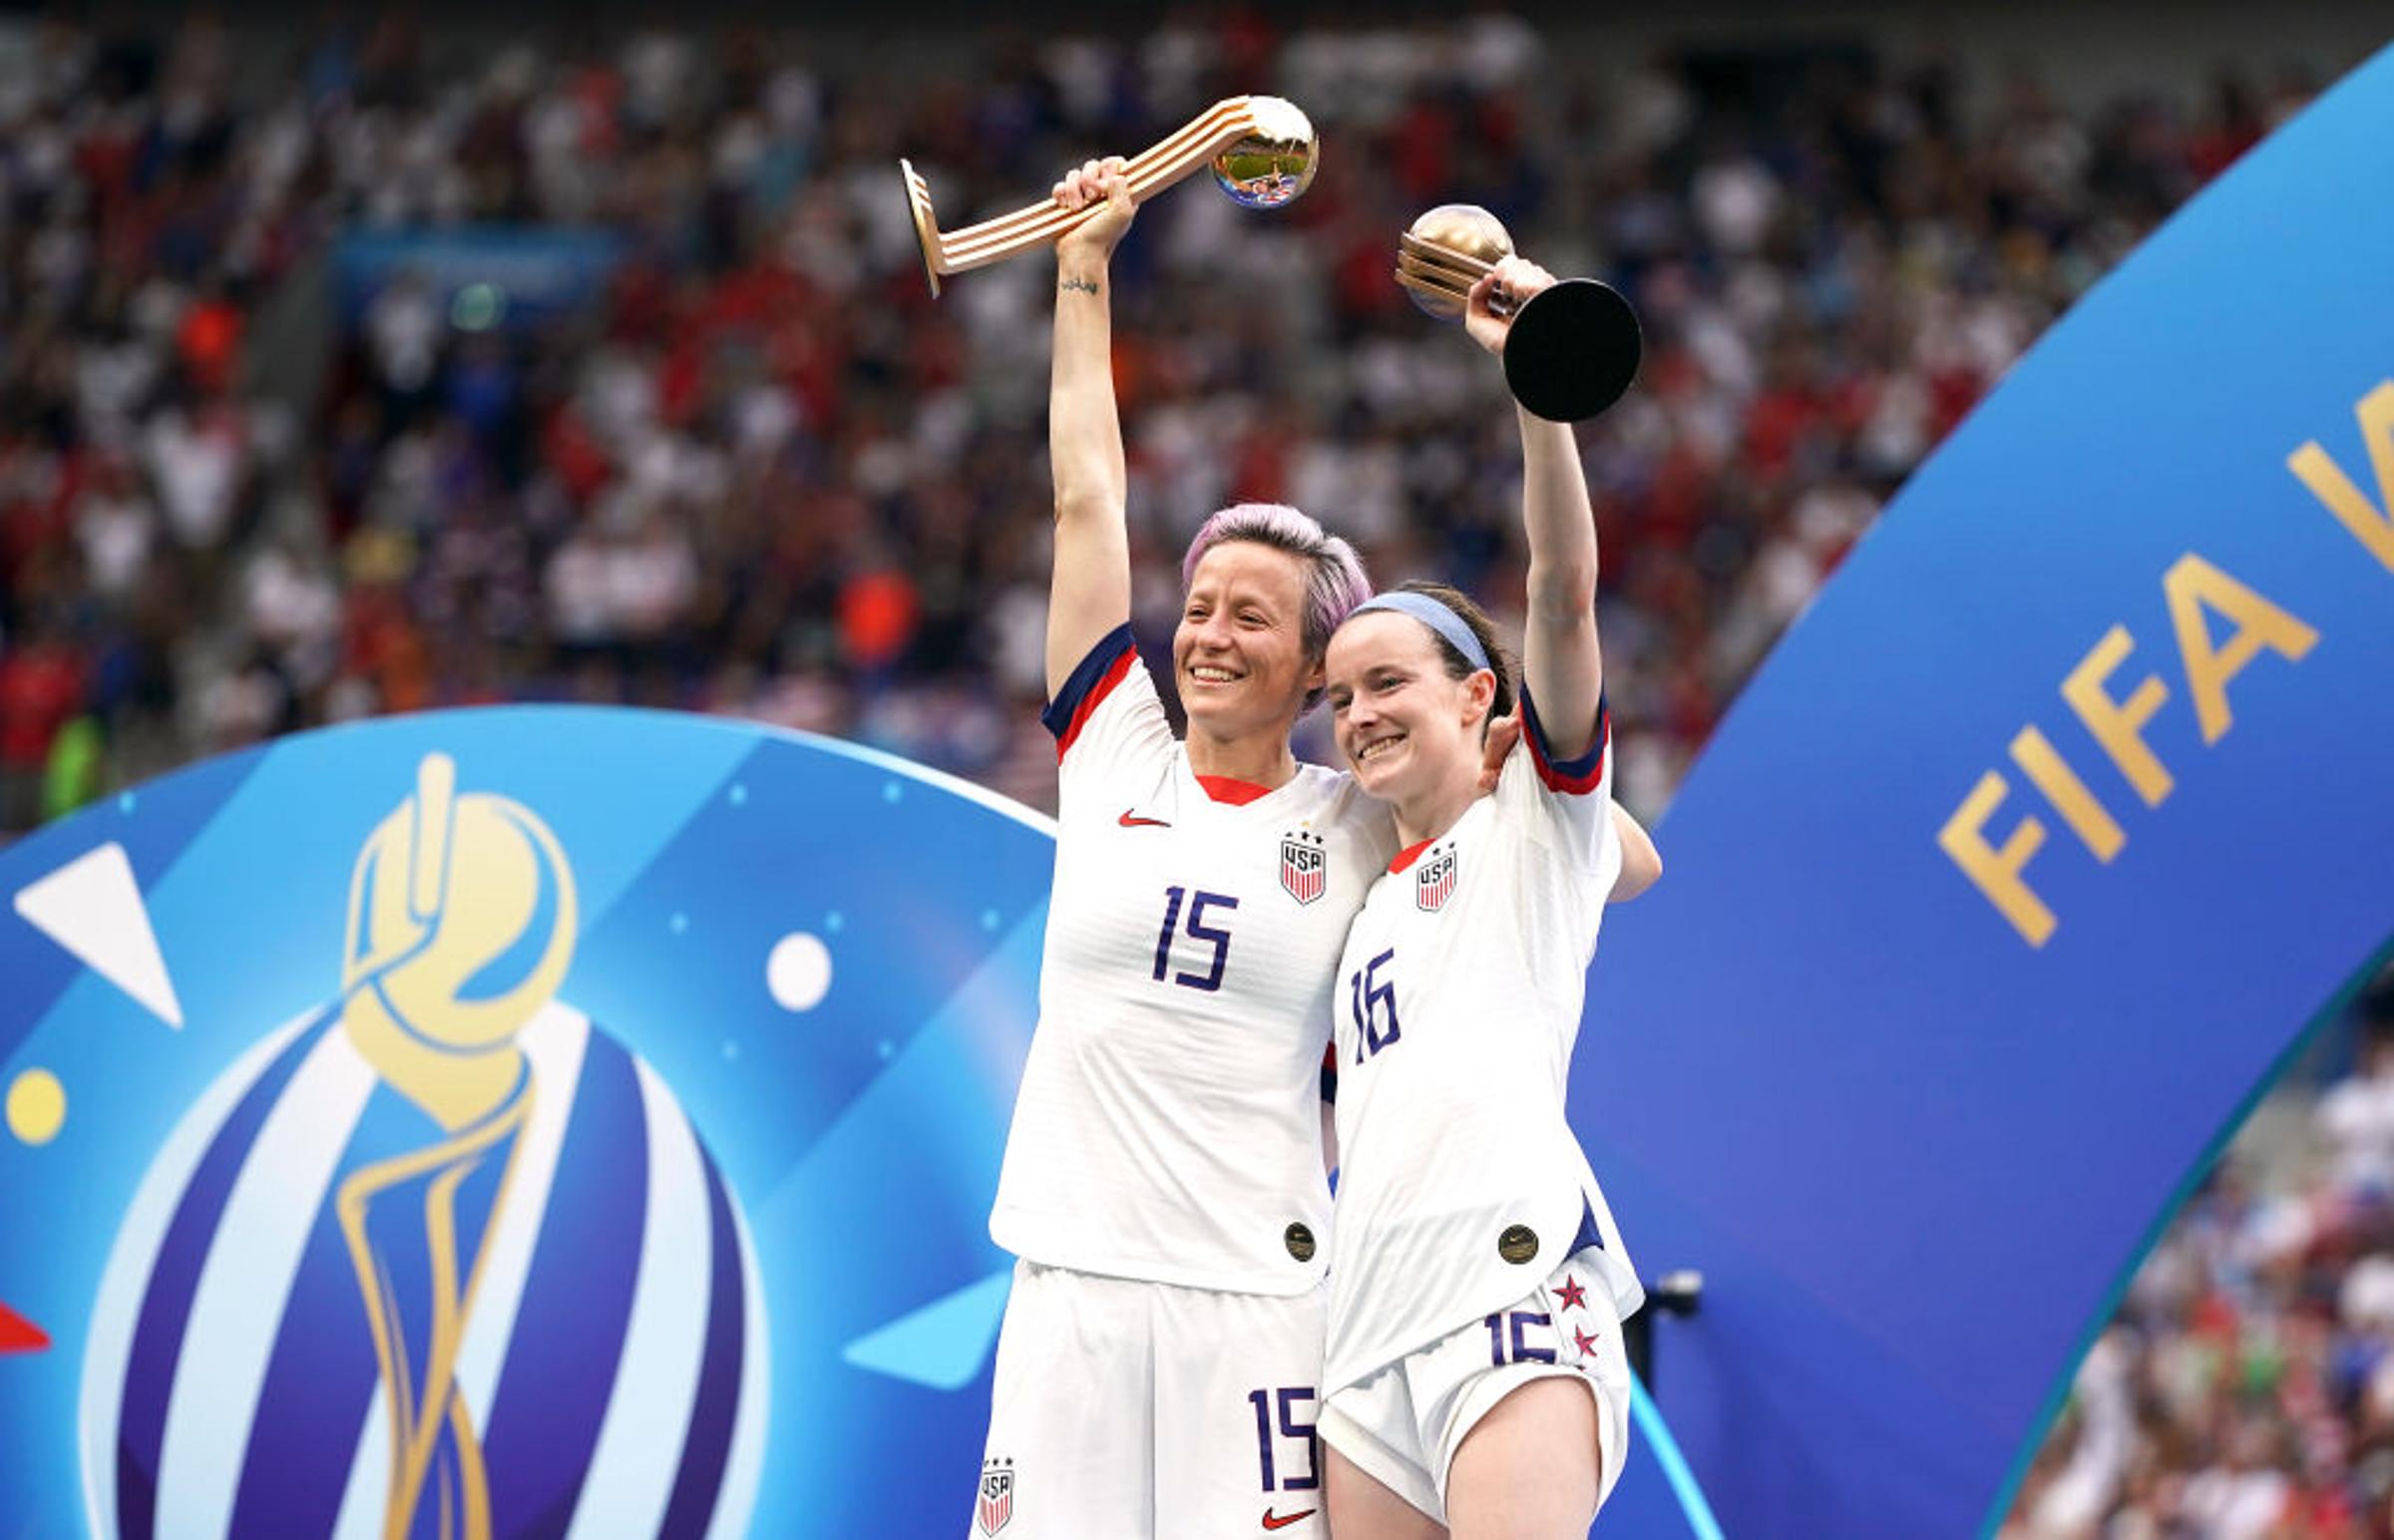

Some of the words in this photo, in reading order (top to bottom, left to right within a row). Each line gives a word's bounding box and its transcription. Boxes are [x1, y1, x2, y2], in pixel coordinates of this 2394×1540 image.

[1937, 552, 2320, 949] FIFA
[1285, 845, 1322, 872] USA
[1420, 857, 1452, 884] USA
[1152, 885, 1239, 991] 15
[1351, 947, 1400, 1065] 16
[1248, 1384, 1319, 1491] 15
